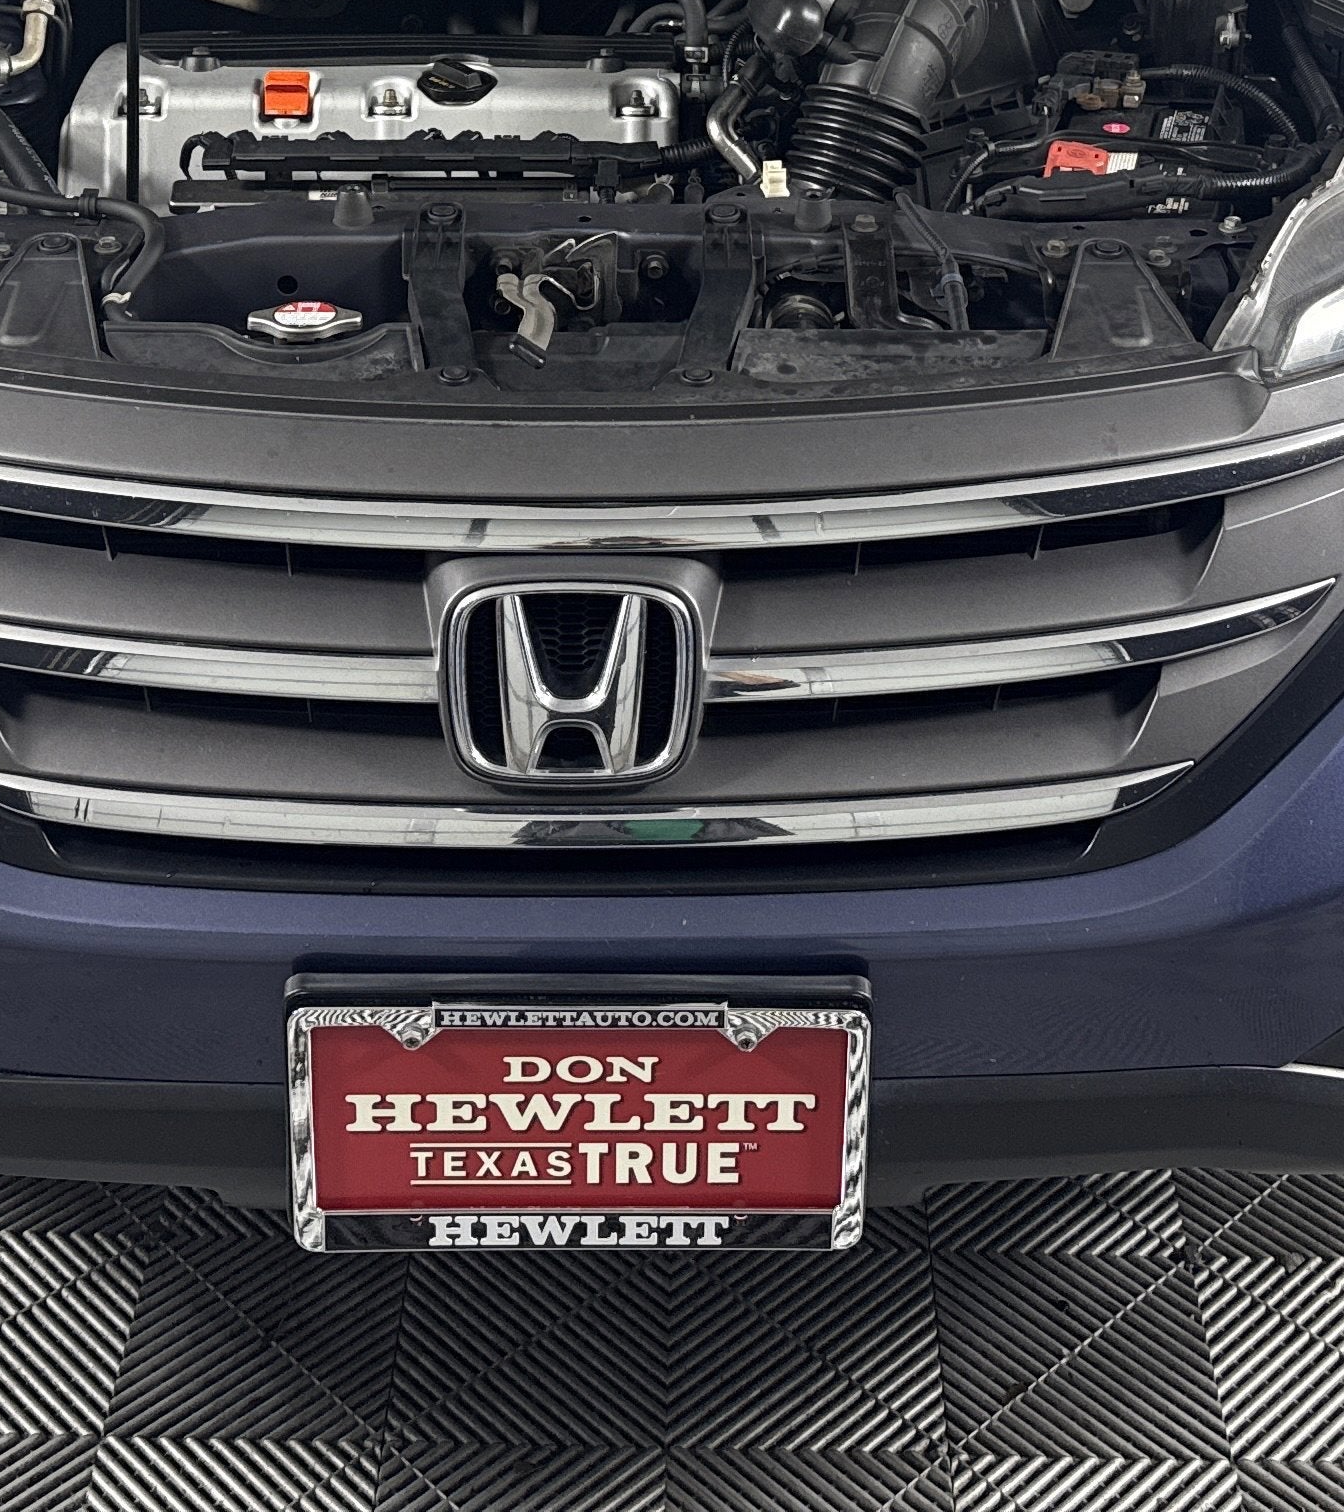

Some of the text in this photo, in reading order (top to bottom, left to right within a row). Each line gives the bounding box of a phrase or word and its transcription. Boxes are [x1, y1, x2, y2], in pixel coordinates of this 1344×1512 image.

[441, 1010, 718, 1028] HEWLETTAUTO.COM
[502, 1056, 659, 1083] DON
[345, 1093, 816, 1133] HEWLETT
[428, 1215, 730, 1246] HEWLETT
